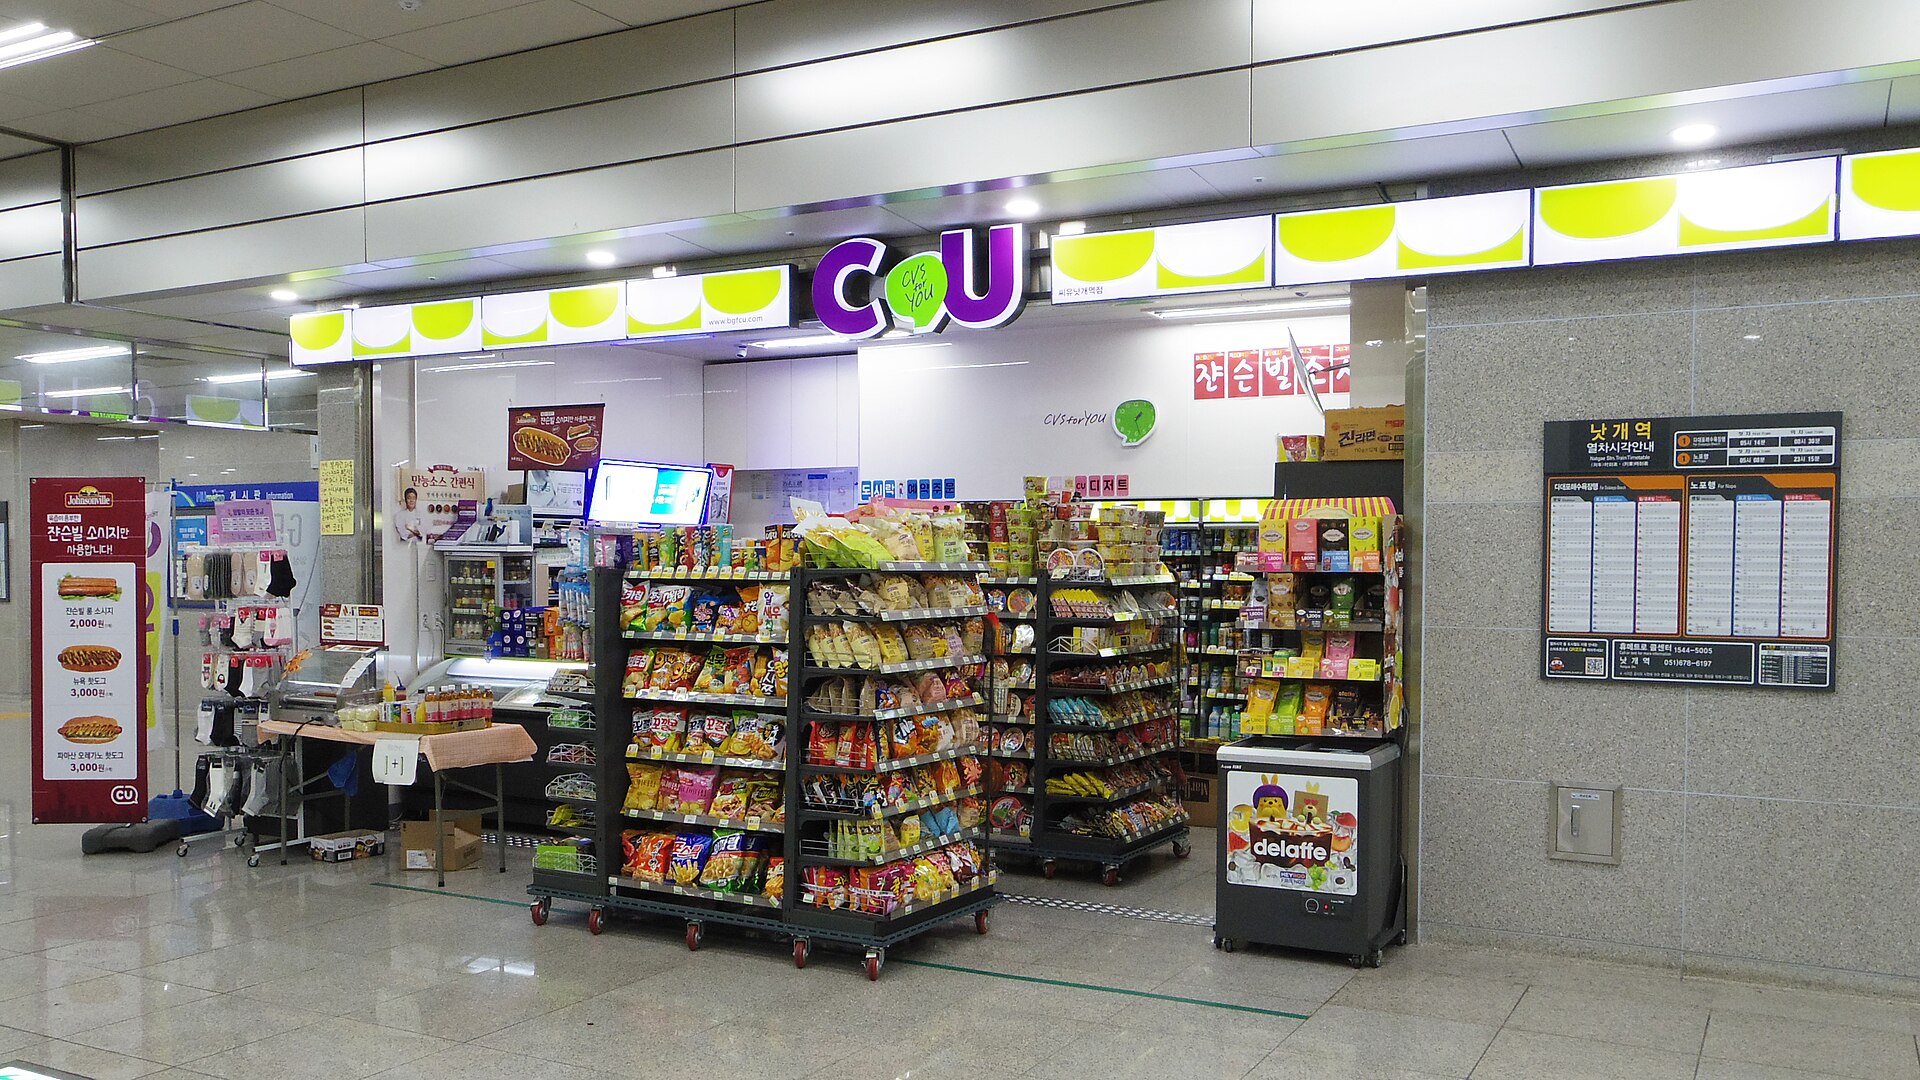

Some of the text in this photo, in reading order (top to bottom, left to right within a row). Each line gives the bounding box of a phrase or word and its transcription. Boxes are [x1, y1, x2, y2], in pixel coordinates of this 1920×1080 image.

[812, 222, 1024, 339] CU
[902, 263, 926, 287] CVS
[914, 279, 927, 292] for
[905, 284, 933, 312] YOU
[708, 316, 763, 325] www.bgfcu.com
[1339, 430, 1376, 448] 진라면
[1587, 441, 1654, 454] 열차시각안내
[412, 475, 475, 489] 만능소스 간편식
[1090, 480, 1128, 491] 디저트
[1690, 480, 1716, 489] 노포행
[862, 484, 896, 495] 도시락
[68, 495, 110, 505] Johnsonville
[266, 491, 293, 500] Information
[48, 526, 130, 541] 쟌슨빌 소시지만
[67, 544, 113, 556] 사용합니다!
[764, 592, 774, 605] 알
[70, 620, 104, 628] 2,000원
[1664, 659, 1712, 667] 051)678-6197
[71, 689, 105, 697] 3,000원
[70, 763, 105, 772] 3,000원
[116, 790, 133, 800] CU
[1253, 838, 1328, 861] delaffe
